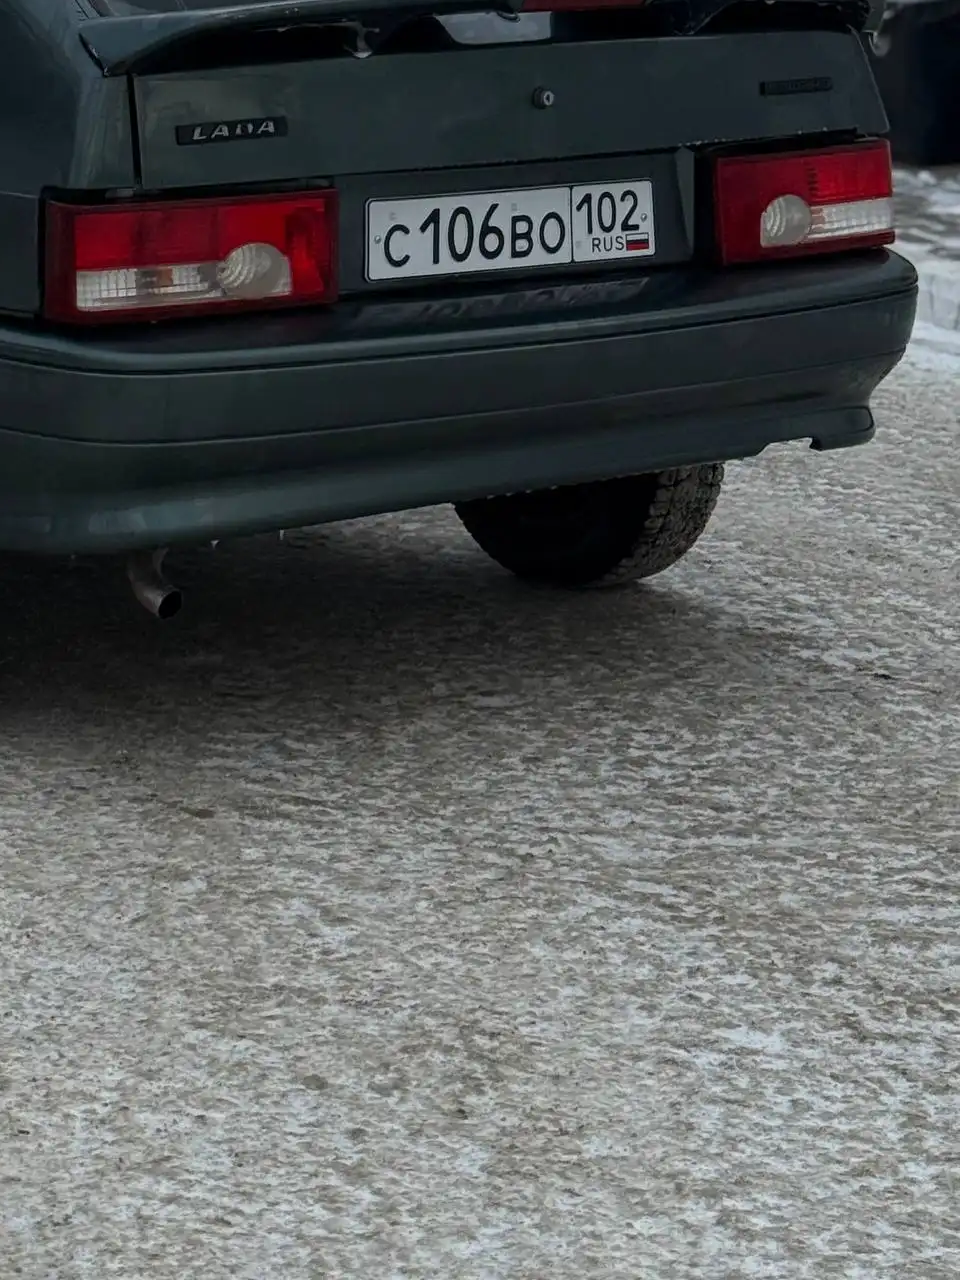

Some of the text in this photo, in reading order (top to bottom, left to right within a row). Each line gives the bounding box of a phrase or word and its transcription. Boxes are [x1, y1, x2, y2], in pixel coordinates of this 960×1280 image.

[192, 120, 275, 140] LADA
[576, 189, 641, 235] 102
[591, 235, 625, 253] RUS
